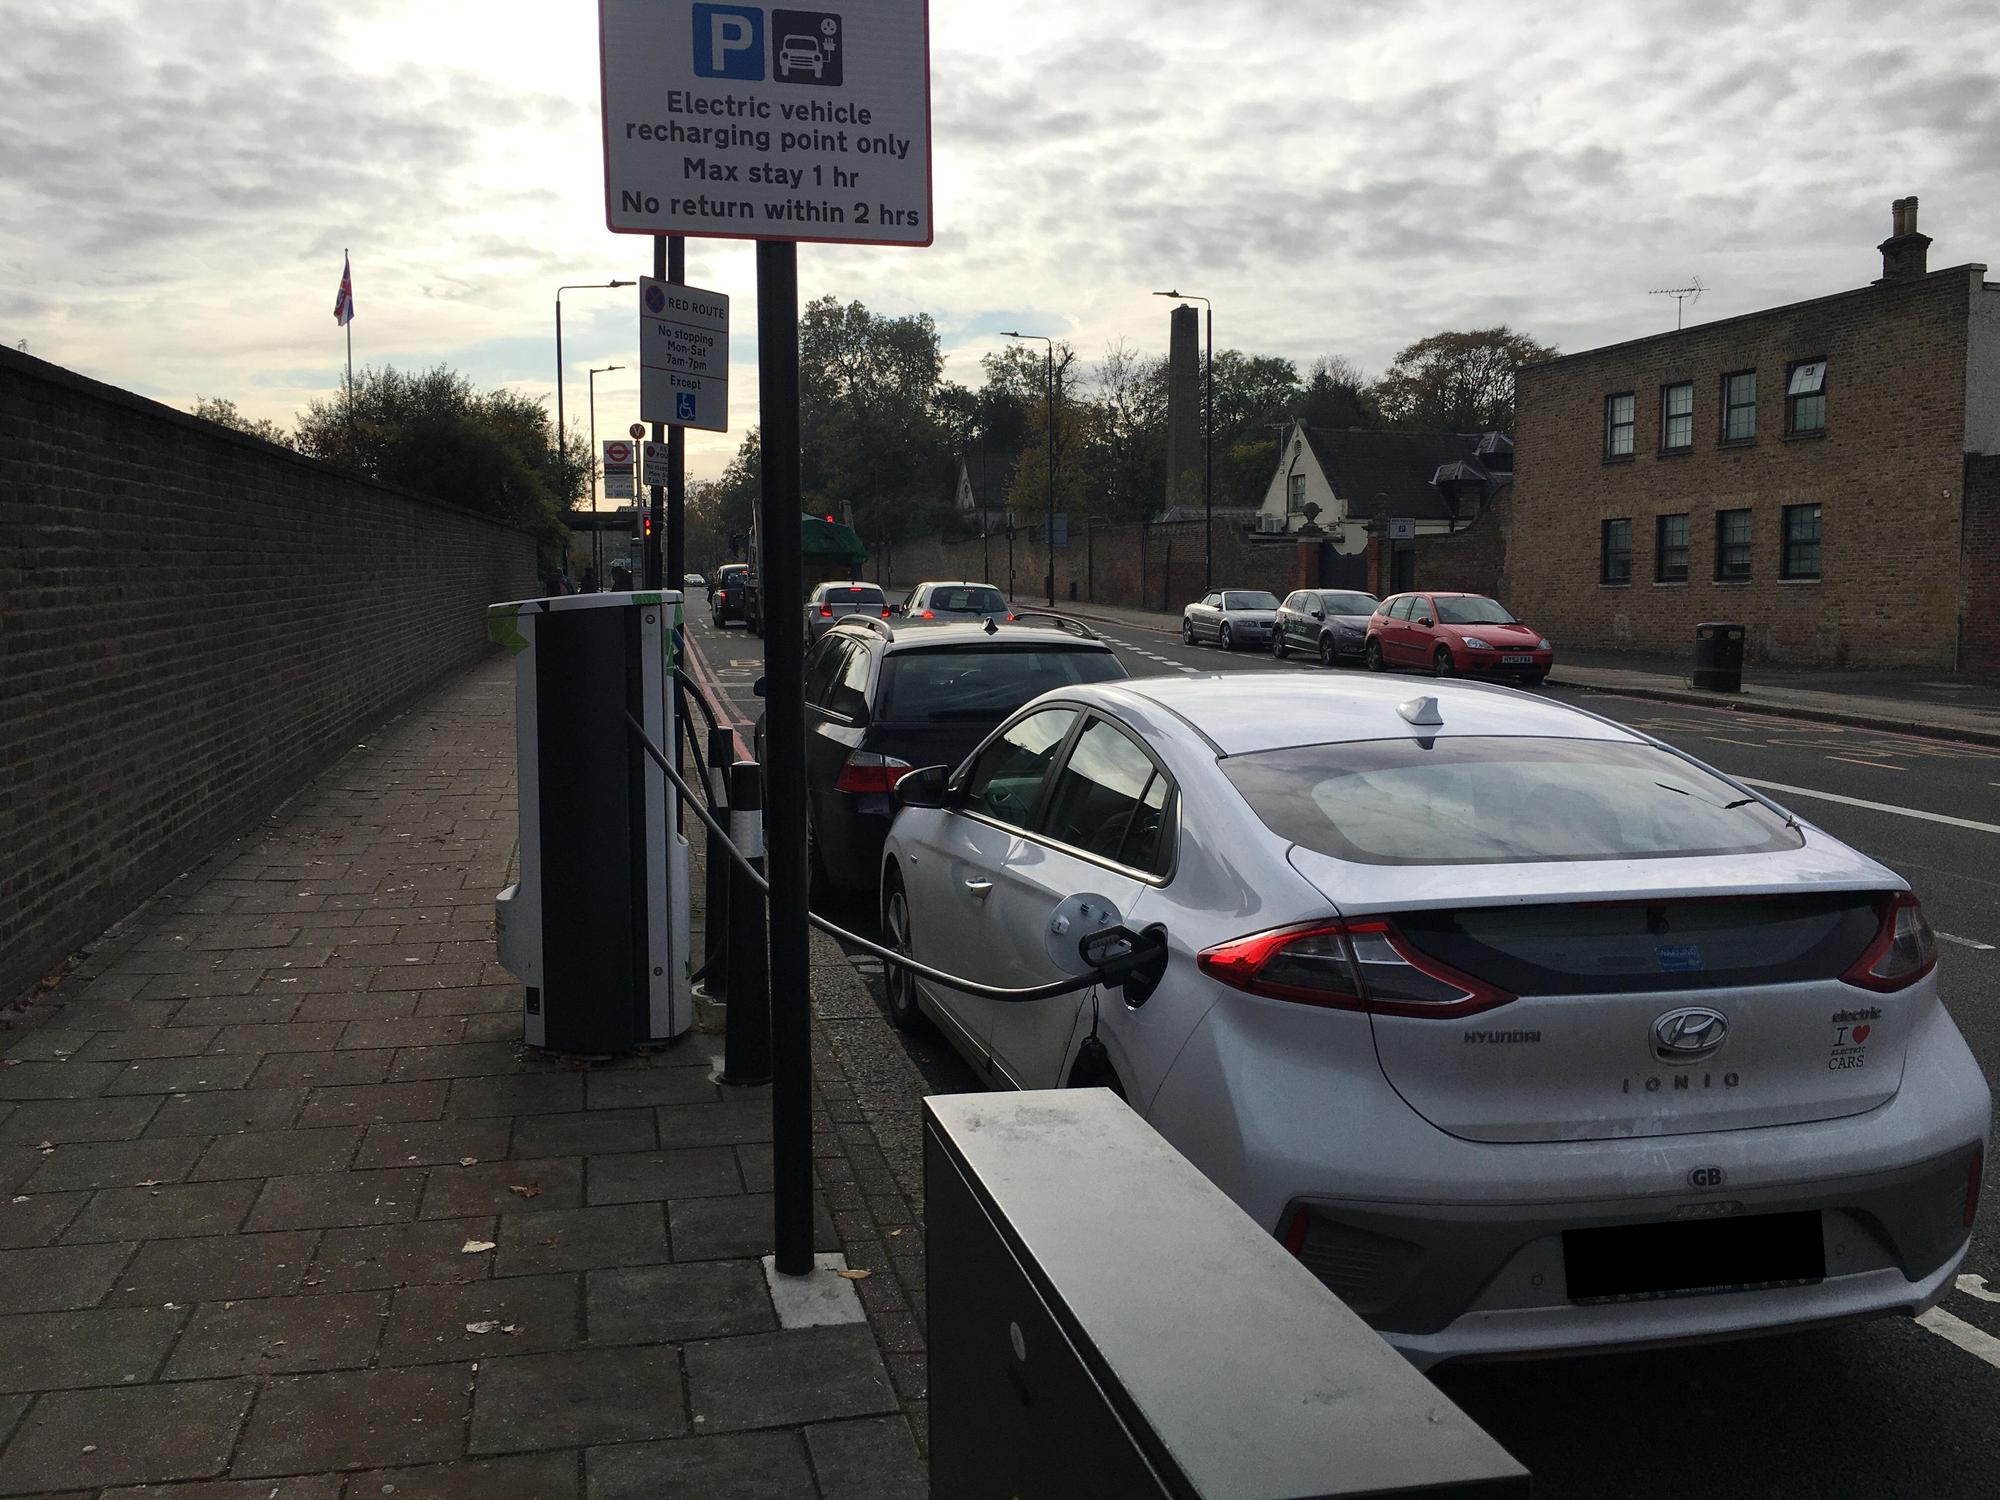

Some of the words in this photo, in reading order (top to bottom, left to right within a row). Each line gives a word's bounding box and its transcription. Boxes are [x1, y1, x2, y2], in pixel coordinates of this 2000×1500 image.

[711, 13, 753, 71] P
[667, 90, 770, 119] Electric
[780, 100, 872, 125] vehicle
[626, 120, 770, 150] recharging
[781, 128, 848, 153] point
[857, 134, 910, 160] only
[683, 157, 738, 182] Max
[748, 163, 803, 189] stay
[813, 164, 822, 186] 1
[833, 166, 859, 188] hr
[622, 190, 660, 214] No
[671, 195, 754, 219] return
[764, 199, 844, 223] within
[854, 202, 869, 224] 2
[880, 204, 919, 227] hrs
[668, 297, 689, 311] RED
[692, 303, 725, 319] ROUTE
[658, 324, 672, 337] No
[674, 329, 714, 347] stopping
[667, 340, 707, 358] Mon-Sat
[666, 353, 707, 371] 7am-7pm
[670, 375, 701, 391] Except
[632, 425, 642, 437] V
[1464, 1030, 1542, 1043] HYUNDAI
[1828, 1055, 1865, 1070] CARS
[1693, 1168, 1721, 1186] GB
